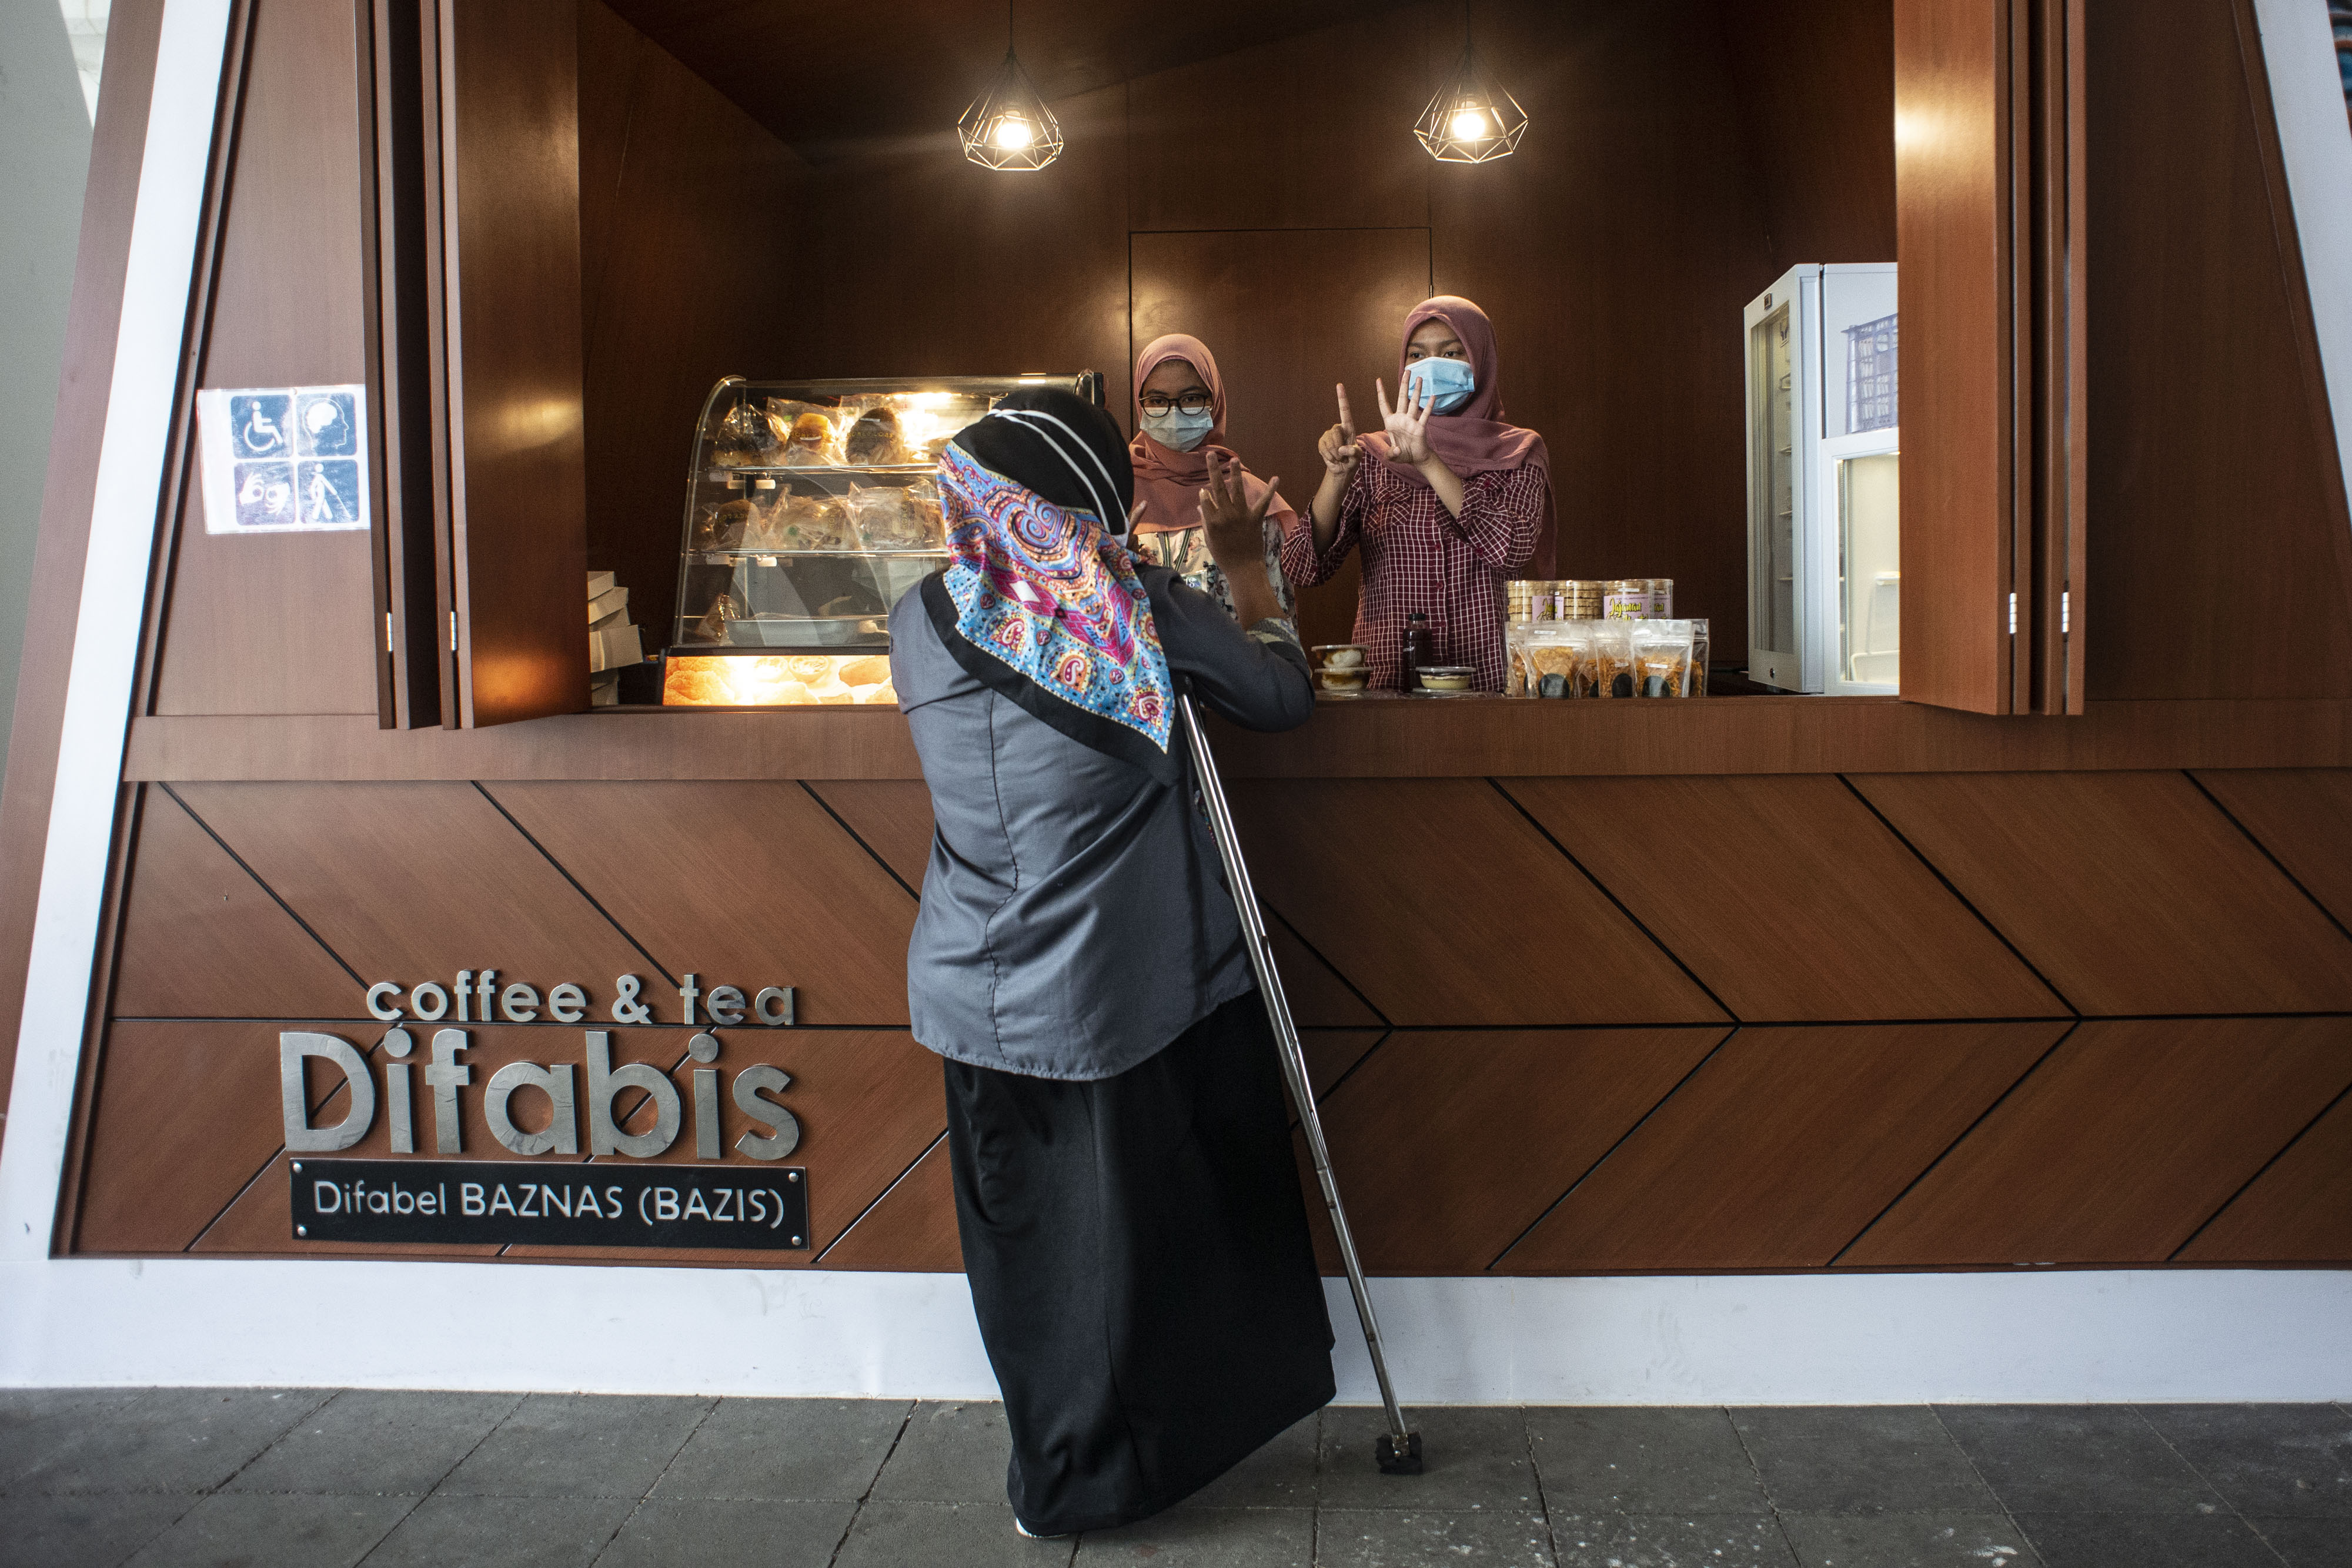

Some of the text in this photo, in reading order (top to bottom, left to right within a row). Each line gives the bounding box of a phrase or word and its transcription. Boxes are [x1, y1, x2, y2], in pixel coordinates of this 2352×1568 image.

[1609, 597, 1642, 618] Jajanan
[366, 968, 795, 1026] coffee & tea
[279, 1028, 801, 1160] Difabis
[313, 1180, 784, 1229] Difabel BAZNAS (BAZIS)
